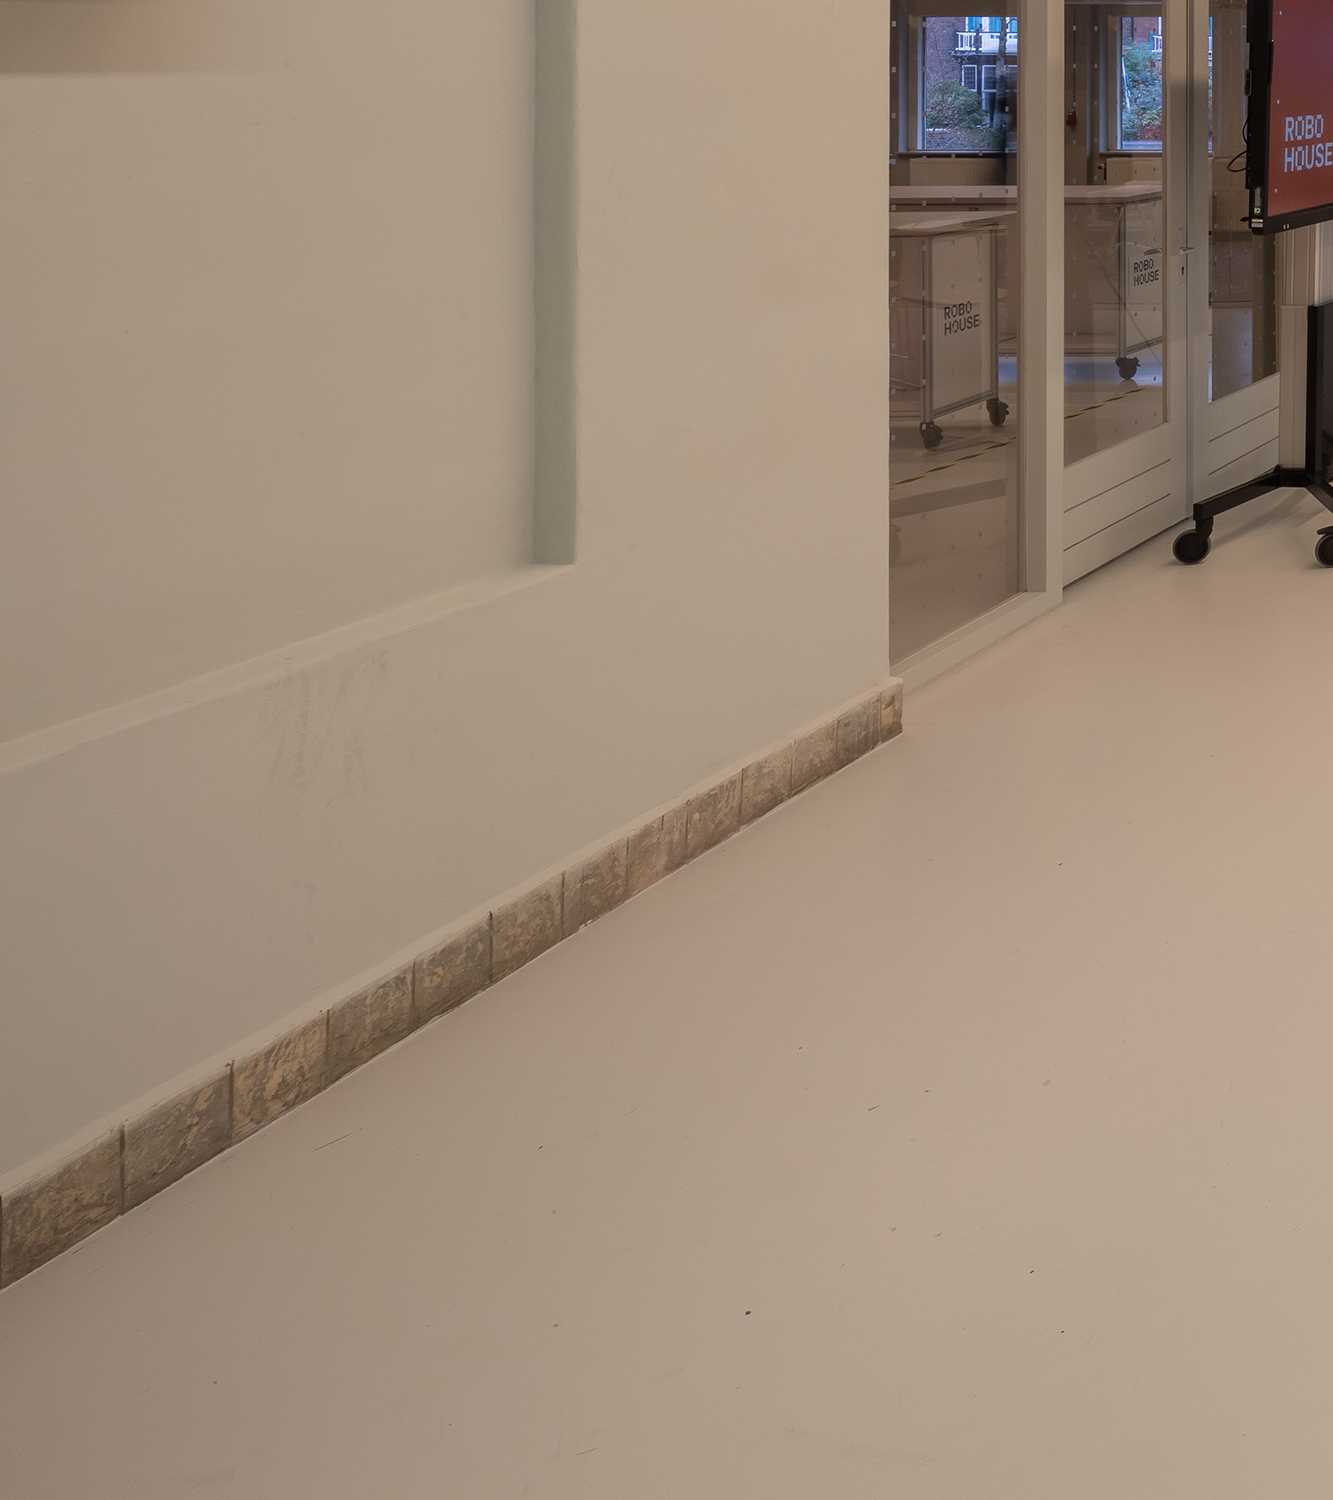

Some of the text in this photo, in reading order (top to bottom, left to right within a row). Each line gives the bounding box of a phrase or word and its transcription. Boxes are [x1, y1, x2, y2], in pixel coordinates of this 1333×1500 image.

[1284, 114, 1324, 142] ROBO
[1284, 142, 1333, 173] HOUSE
[1133, 258, 1154, 274] ROBO
[1133, 270, 1159, 286] HOUSE
[944, 301, 972, 320] ROBO
[944, 314, 980, 336] HOUSE
